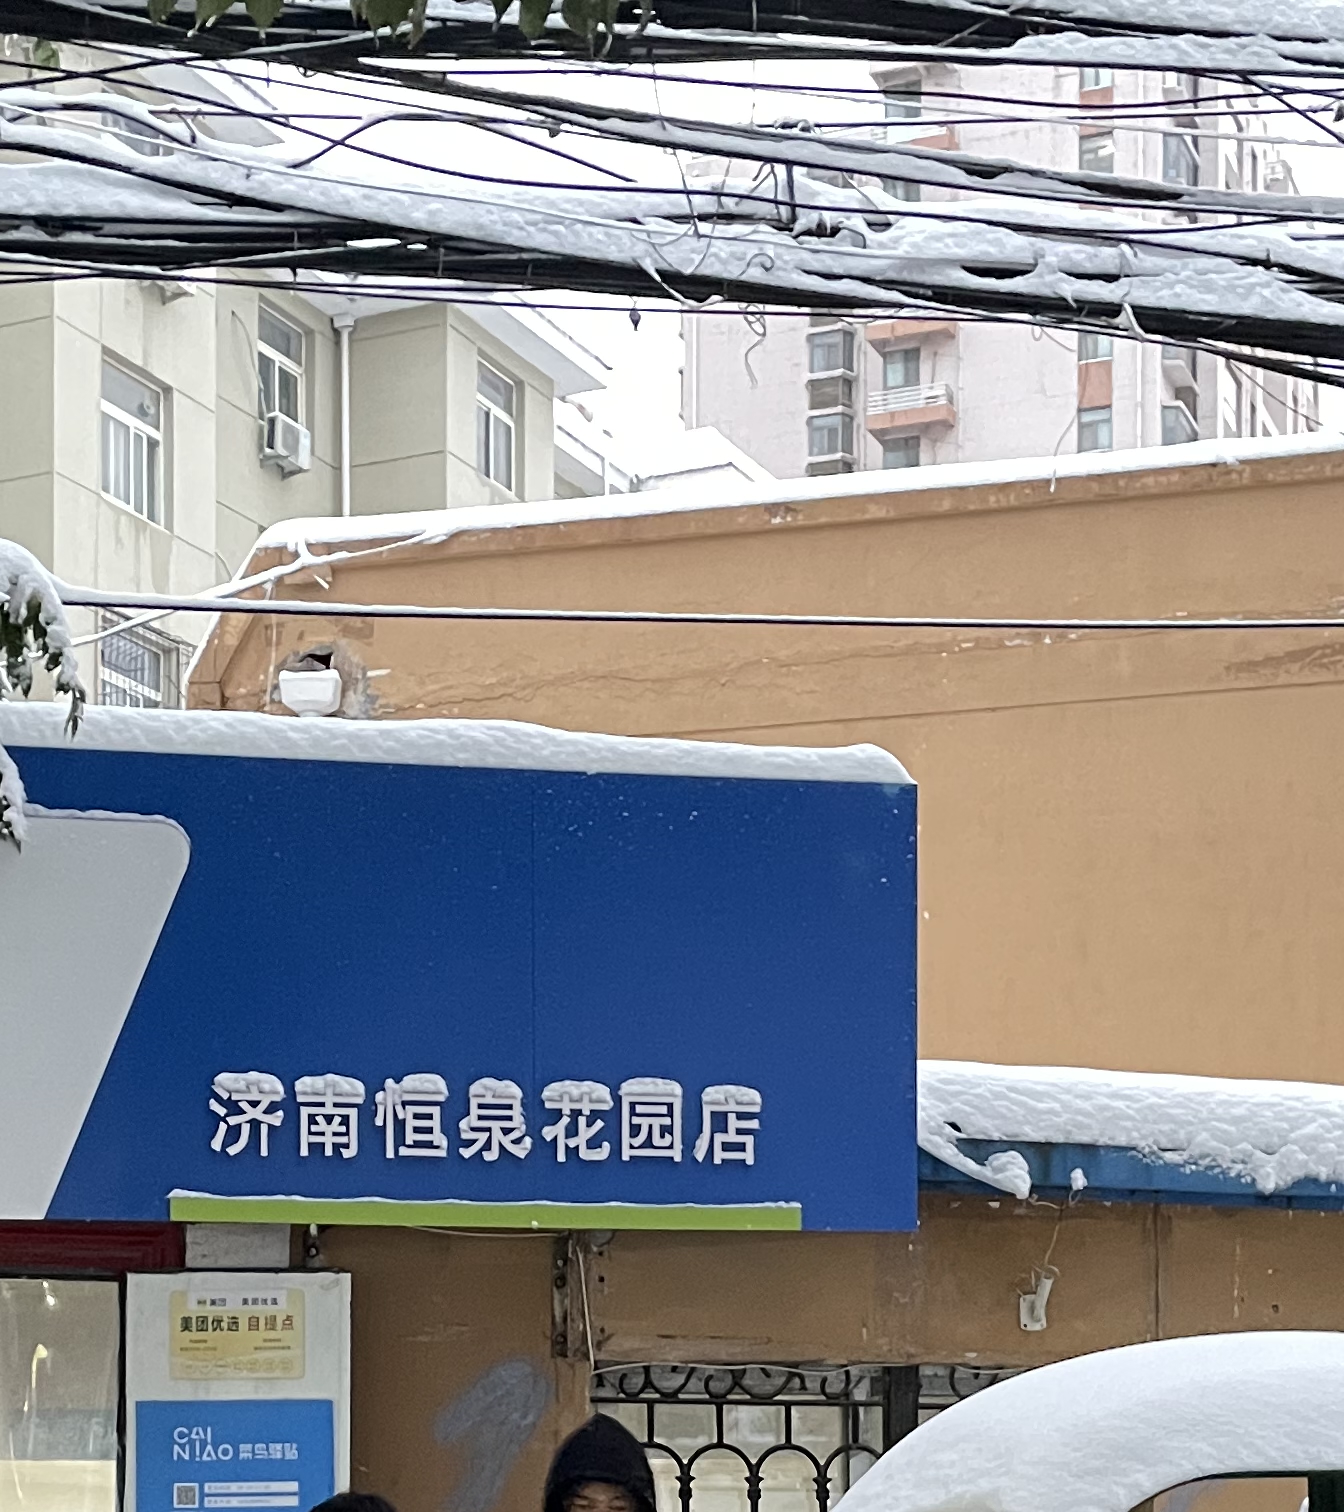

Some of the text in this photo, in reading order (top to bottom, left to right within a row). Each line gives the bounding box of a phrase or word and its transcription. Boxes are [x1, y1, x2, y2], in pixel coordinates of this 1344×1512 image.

[209, 1076, 763, 1166] 济南恒泉花园店
[180, 1315, 294, 1332] 美团优选 自提点
[173, 1426, 211, 1443] CAI
